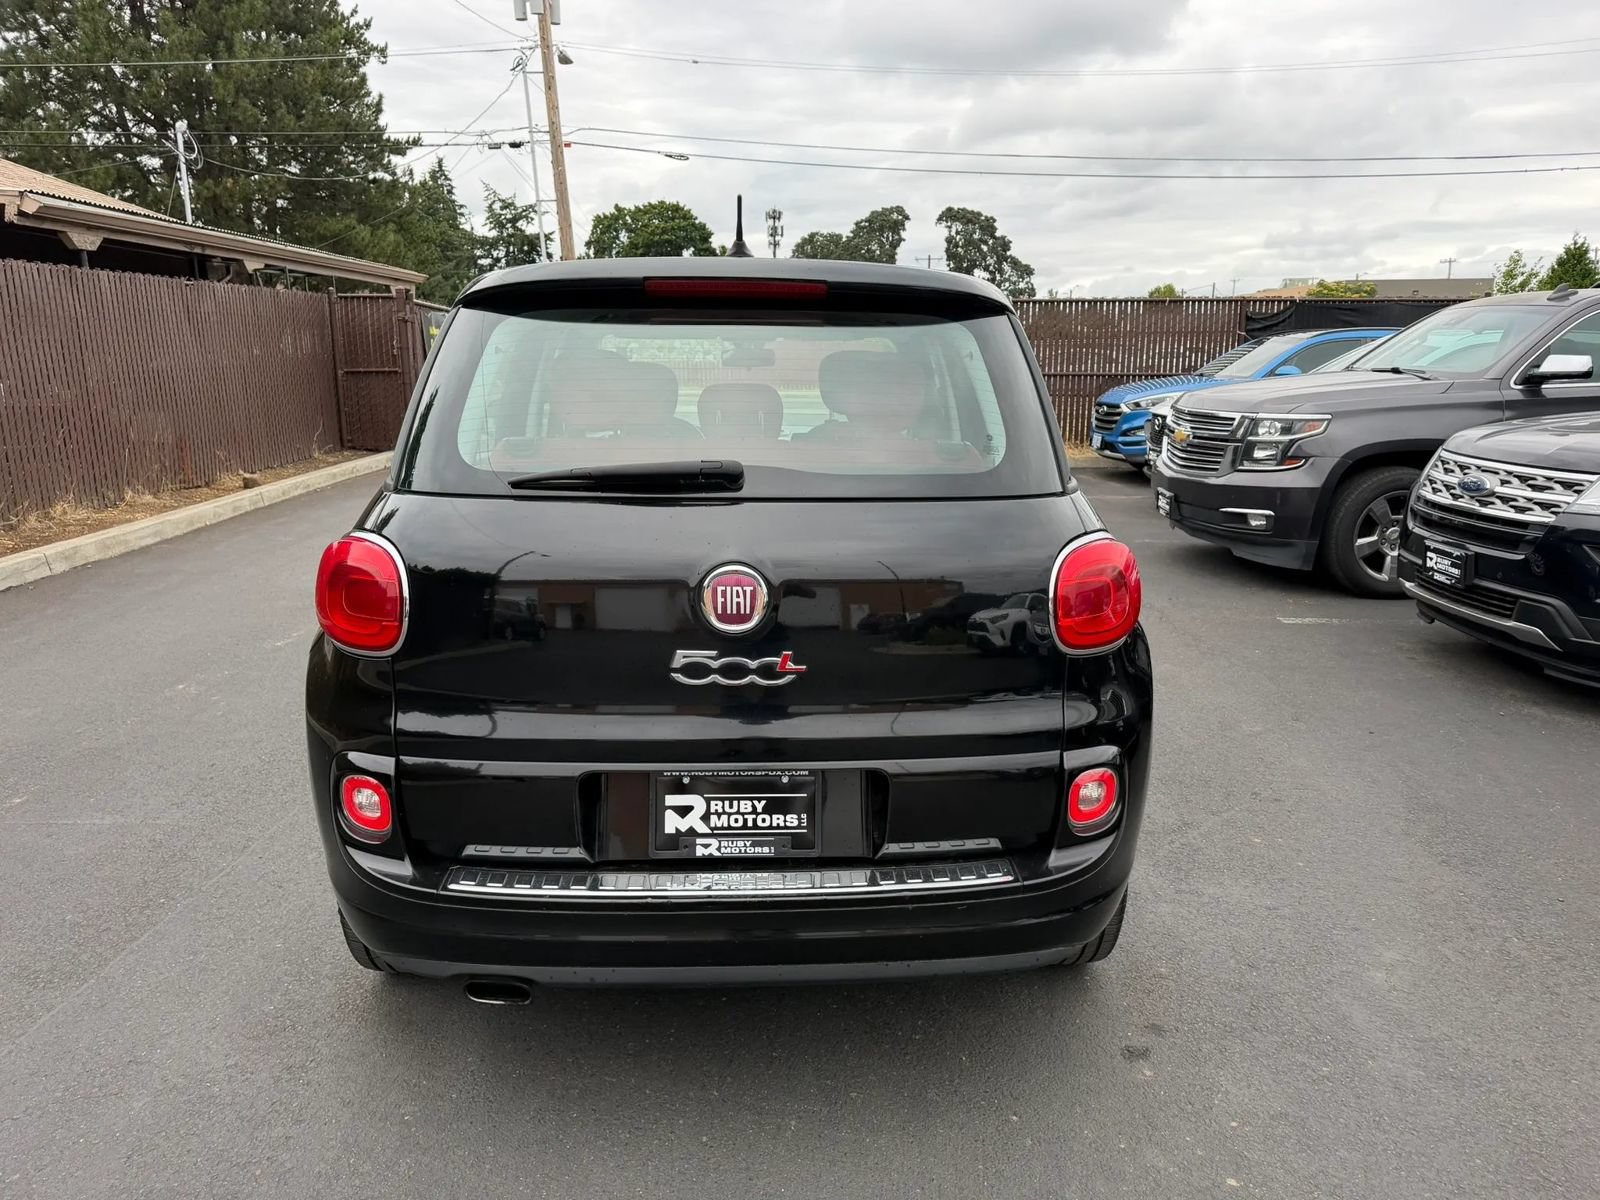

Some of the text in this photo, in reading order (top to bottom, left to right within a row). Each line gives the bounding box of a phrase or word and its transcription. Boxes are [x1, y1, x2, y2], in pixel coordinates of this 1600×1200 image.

[716, 585, 753, 615] FIAT
[669, 649, 808, 687] 500L
[710, 800, 767, 813] RUBY
[710, 814, 799, 828] MOTORS
[720, 846, 770, 854] MOTORS
